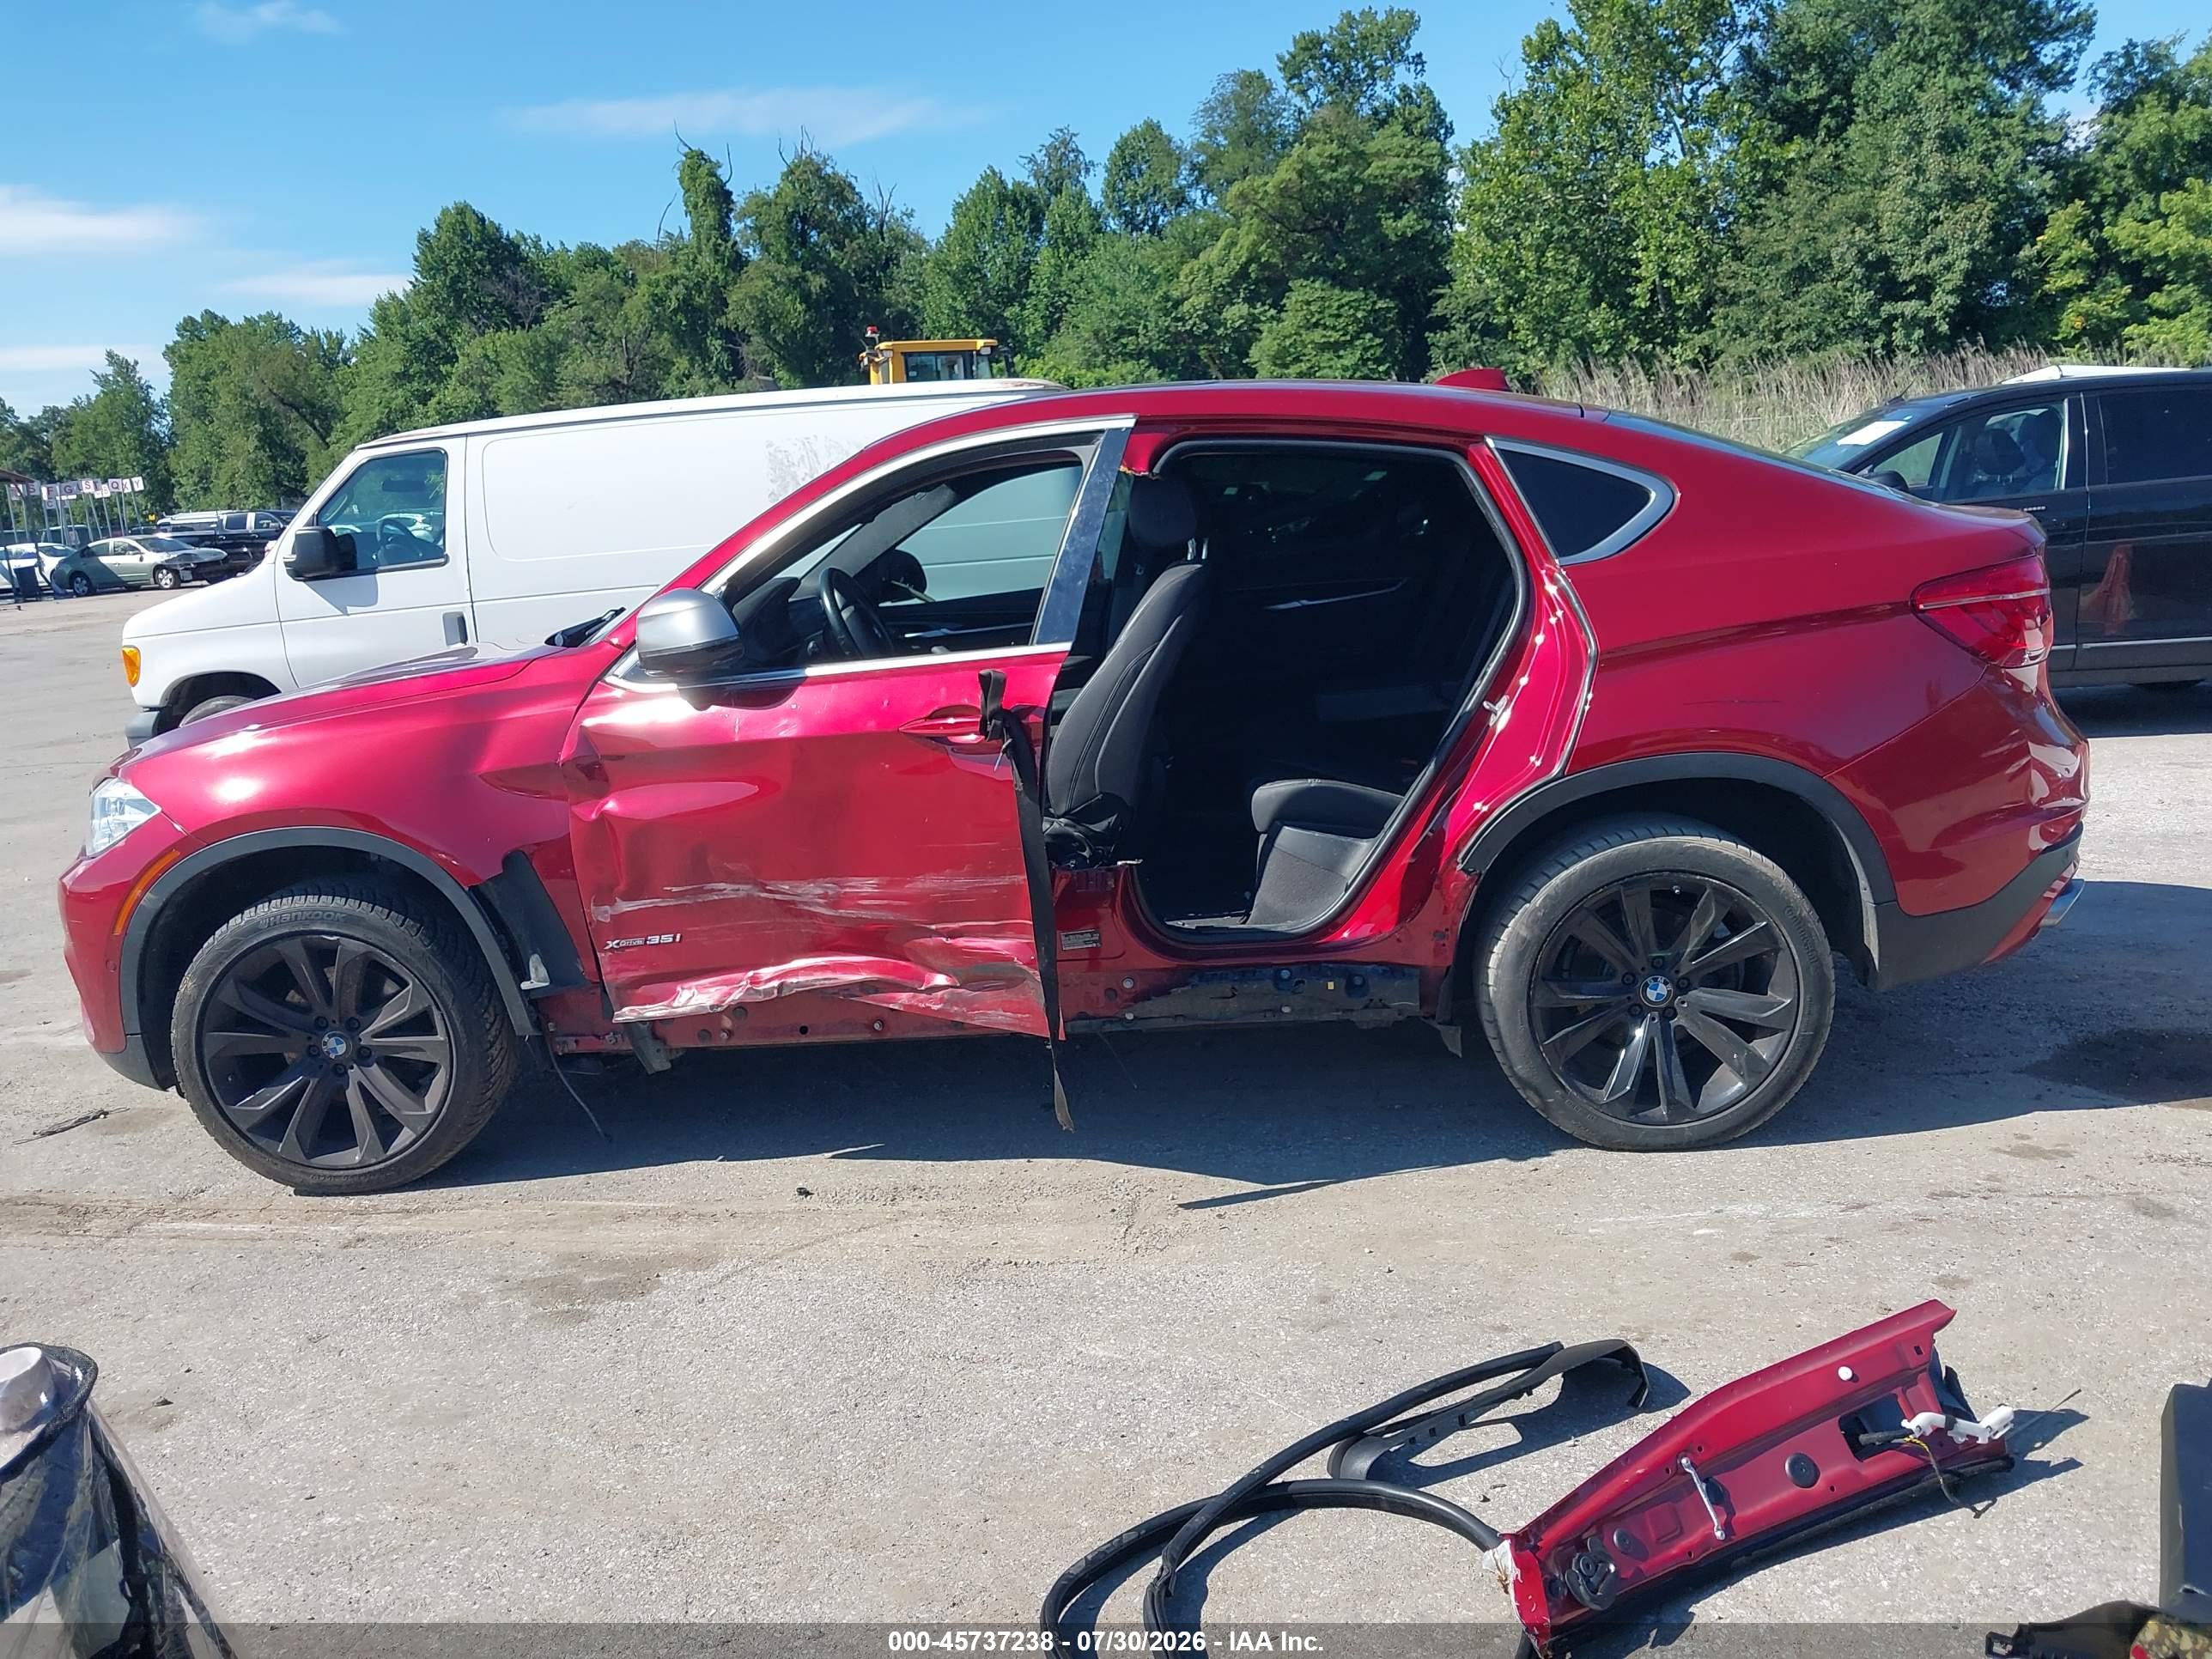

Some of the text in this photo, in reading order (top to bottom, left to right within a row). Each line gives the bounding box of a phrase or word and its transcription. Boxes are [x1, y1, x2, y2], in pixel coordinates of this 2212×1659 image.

[64, 484, 73, 494] G
[84, 480, 91, 489] S
[111, 481, 119, 490] Q
